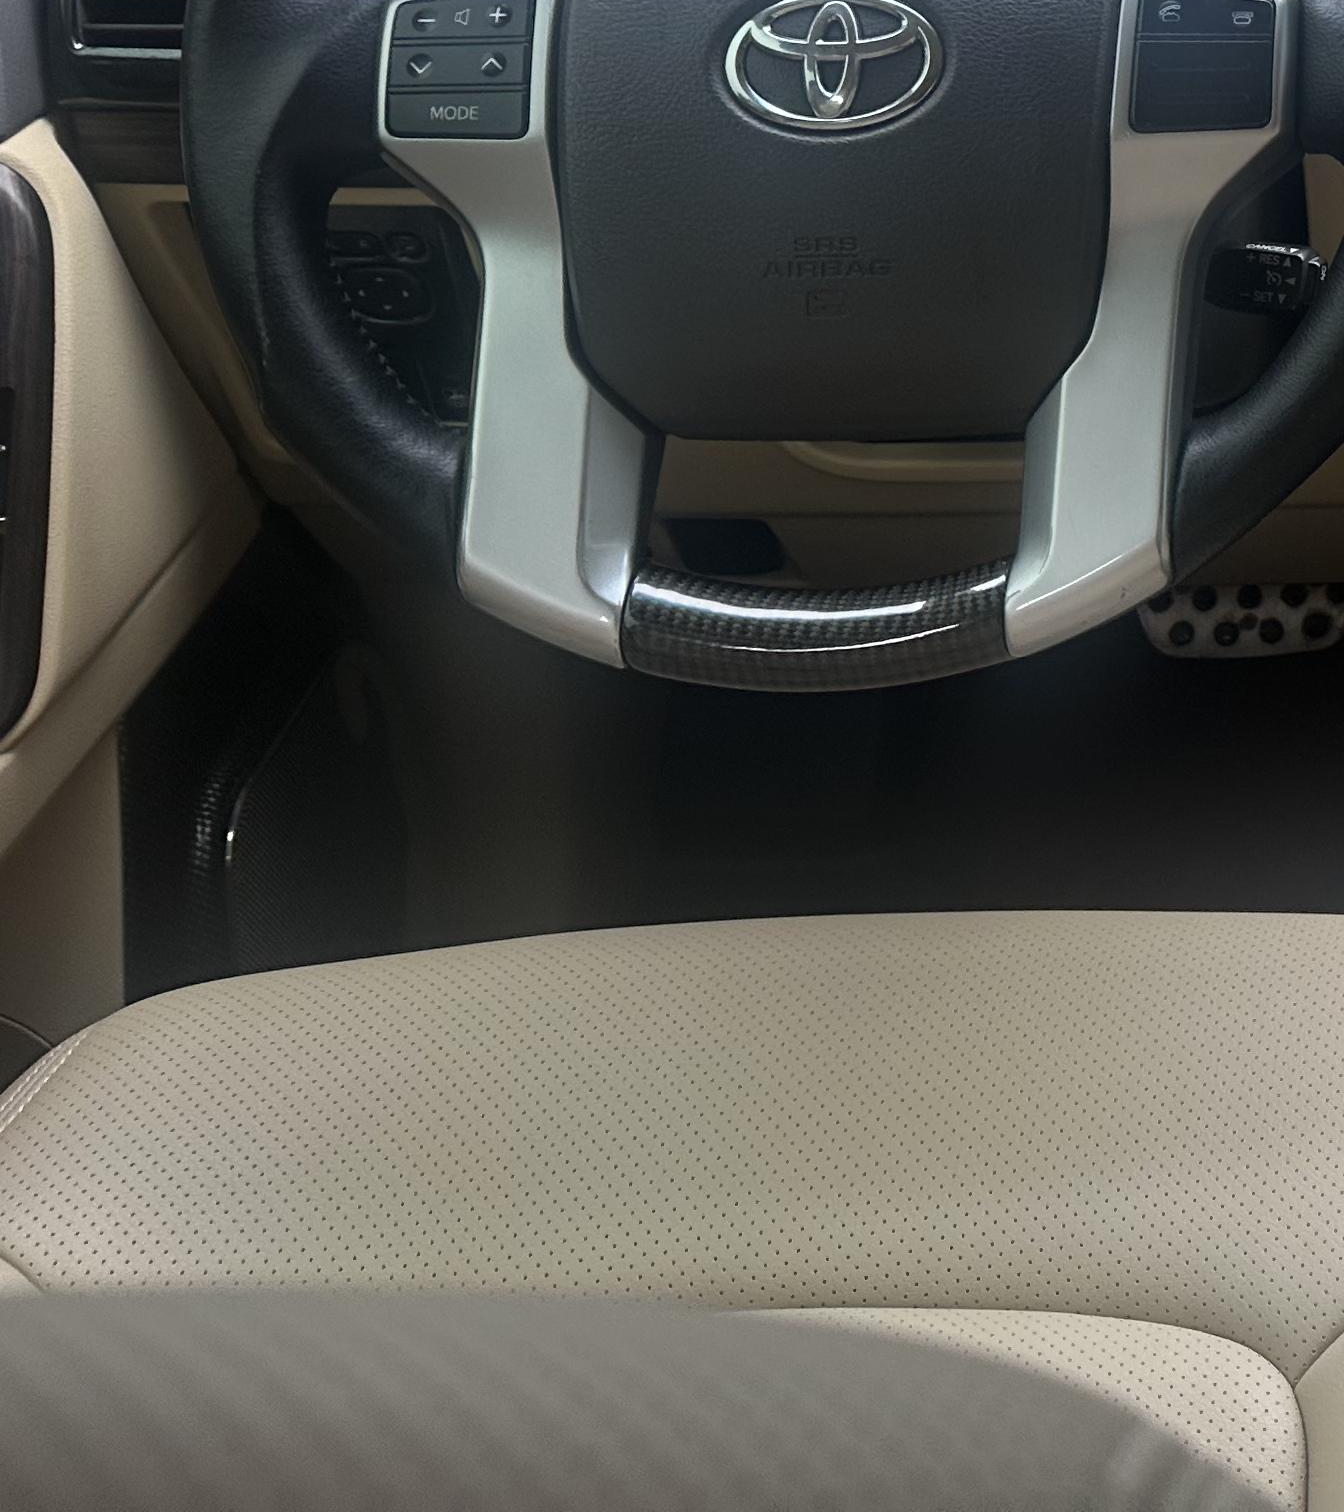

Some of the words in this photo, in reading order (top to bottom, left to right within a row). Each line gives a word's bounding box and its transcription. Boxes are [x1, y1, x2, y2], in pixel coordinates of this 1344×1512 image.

[429, 105, 480, 121] MODE
[793, 236, 859, 253] SRS
[1260, 254, 1281, 265] RES
[762, 258, 894, 279] AIRBAG
[1253, 291, 1274, 303] SET
